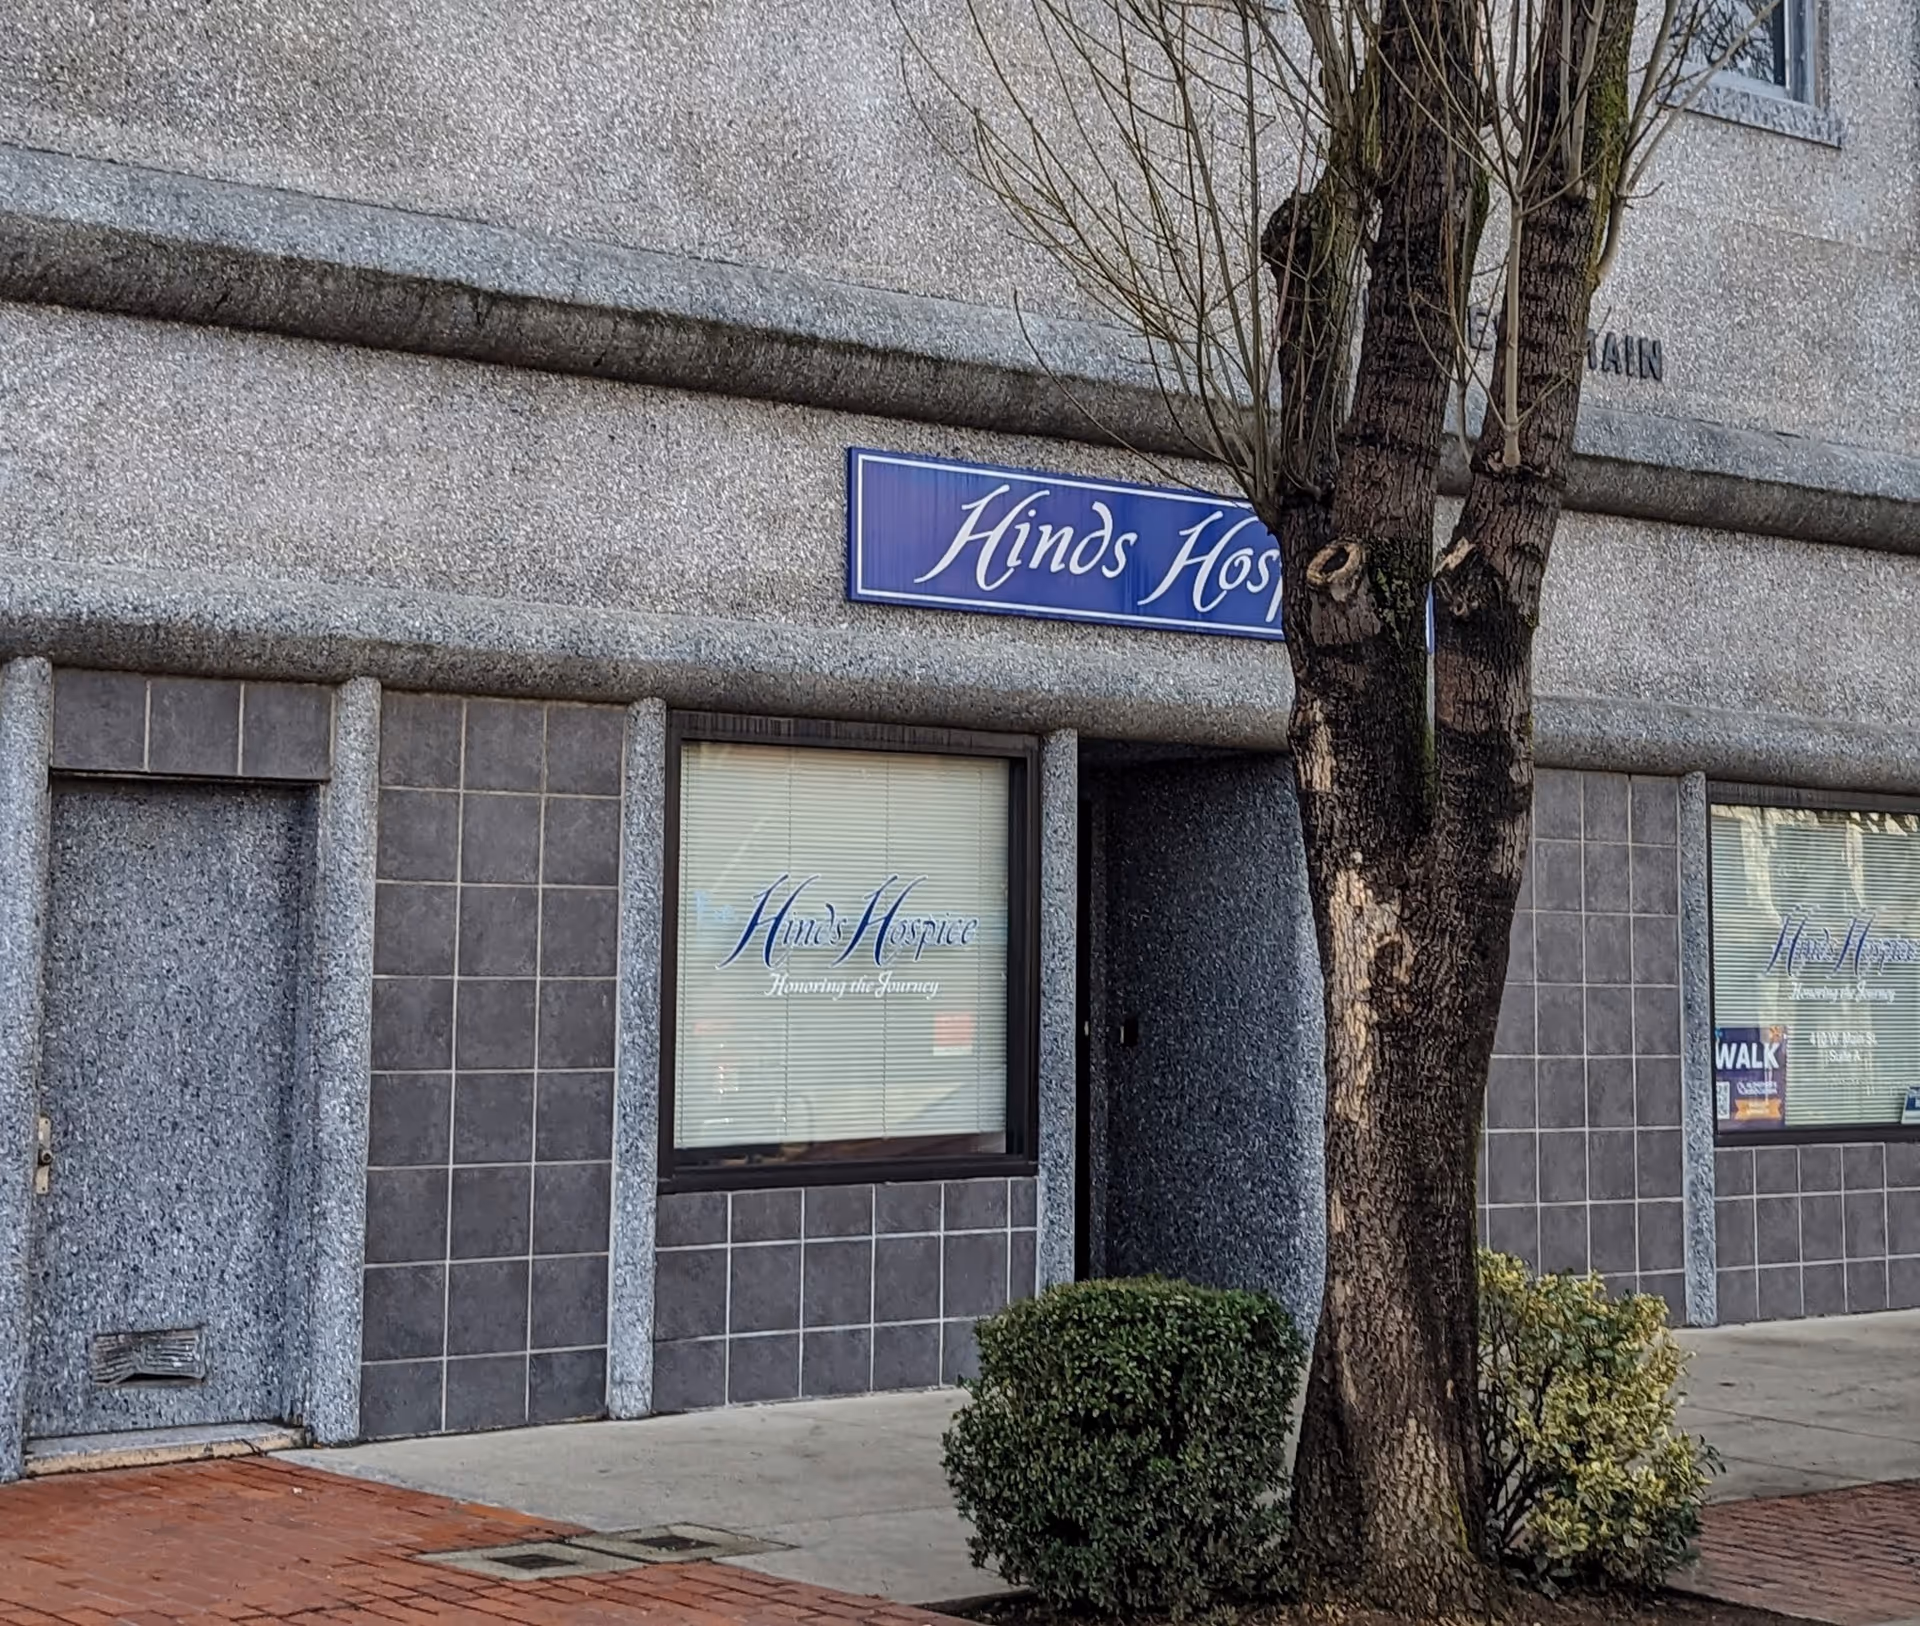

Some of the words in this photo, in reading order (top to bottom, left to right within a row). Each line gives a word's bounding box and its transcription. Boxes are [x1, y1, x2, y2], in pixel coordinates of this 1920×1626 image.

[914, 484, 1138, 591] Hinds
[714, 872, 848, 969] Hinds
[829, 873, 980, 969] Hospice
[765, 971, 847, 1002] Honoring
[849, 974, 875, 994] the
[873, 970, 940, 1001] Journey
[1716, 1042, 1780, 1070] WALK
